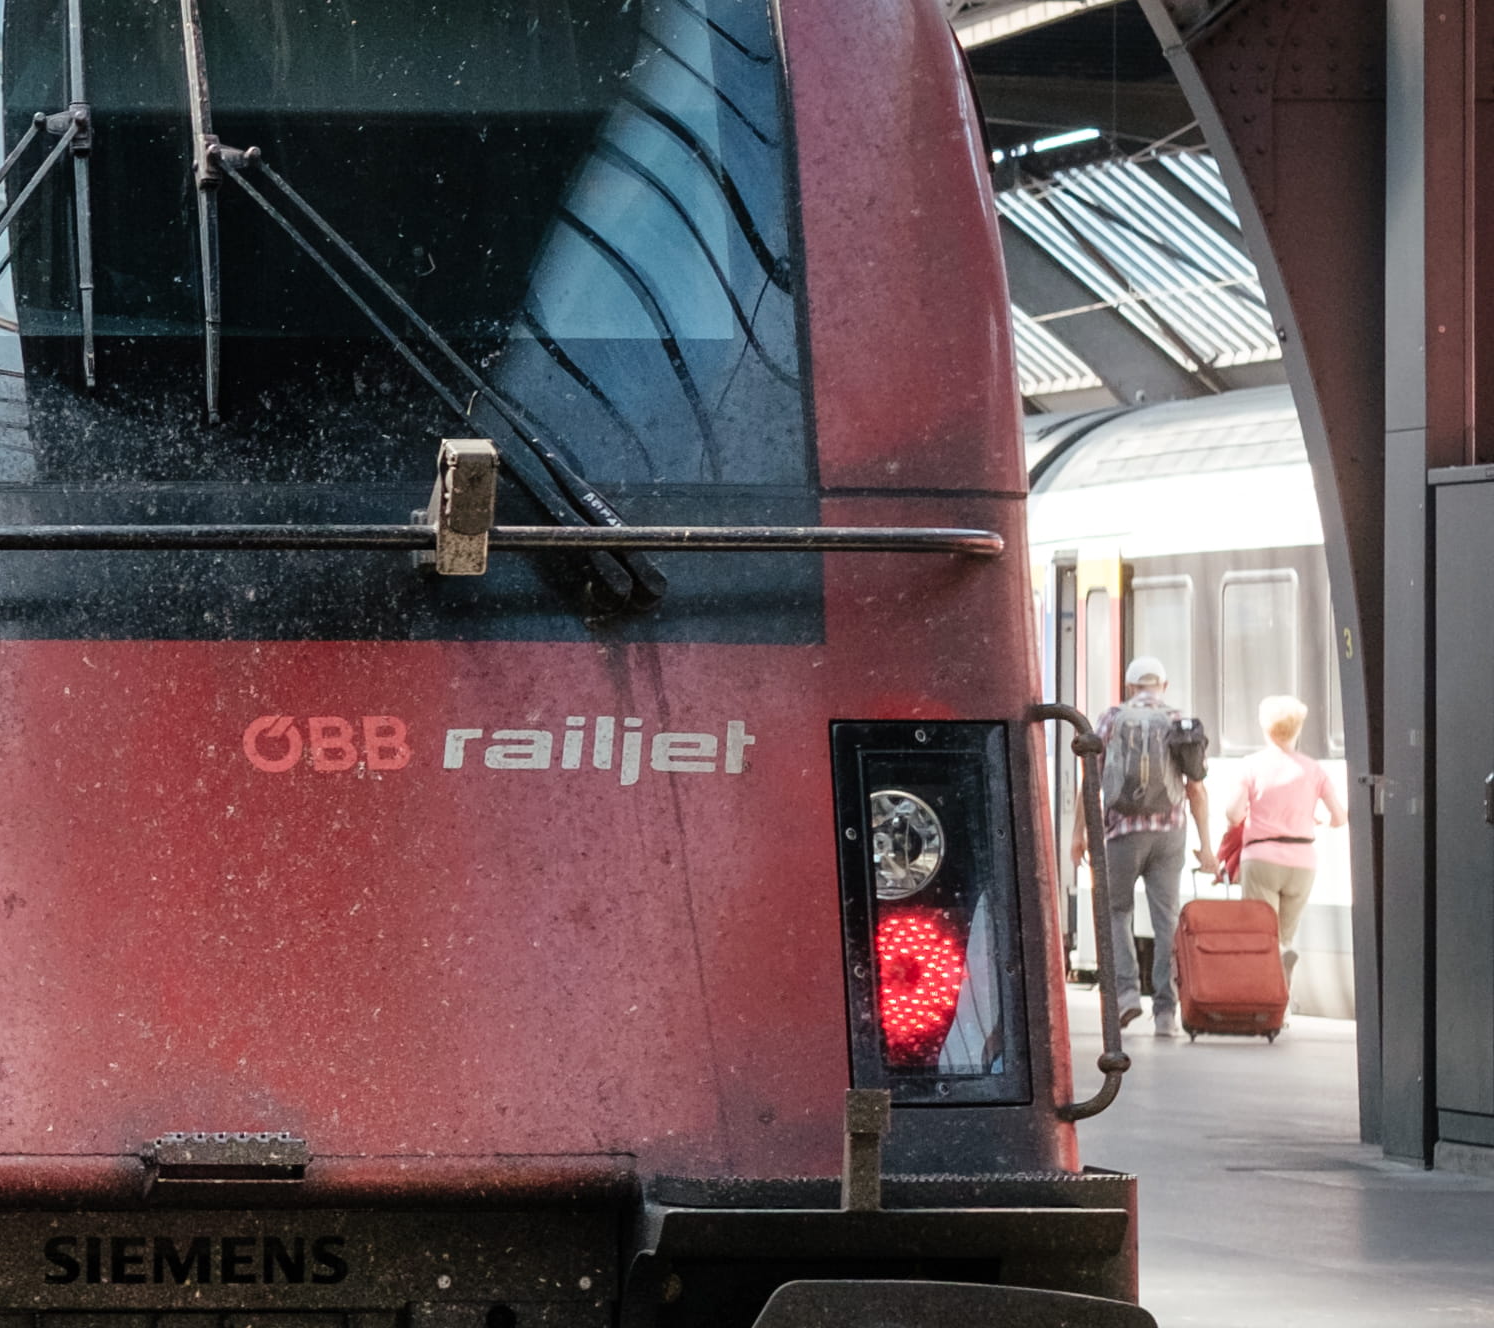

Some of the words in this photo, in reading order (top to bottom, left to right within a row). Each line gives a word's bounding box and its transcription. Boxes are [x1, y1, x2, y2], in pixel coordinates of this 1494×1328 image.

[1343, 627, 1354, 660] 3
[242, 714, 412, 774] ÖBB
[441, 714, 757, 786] railjet
[42, 1234, 349, 1286] SIEMENS
